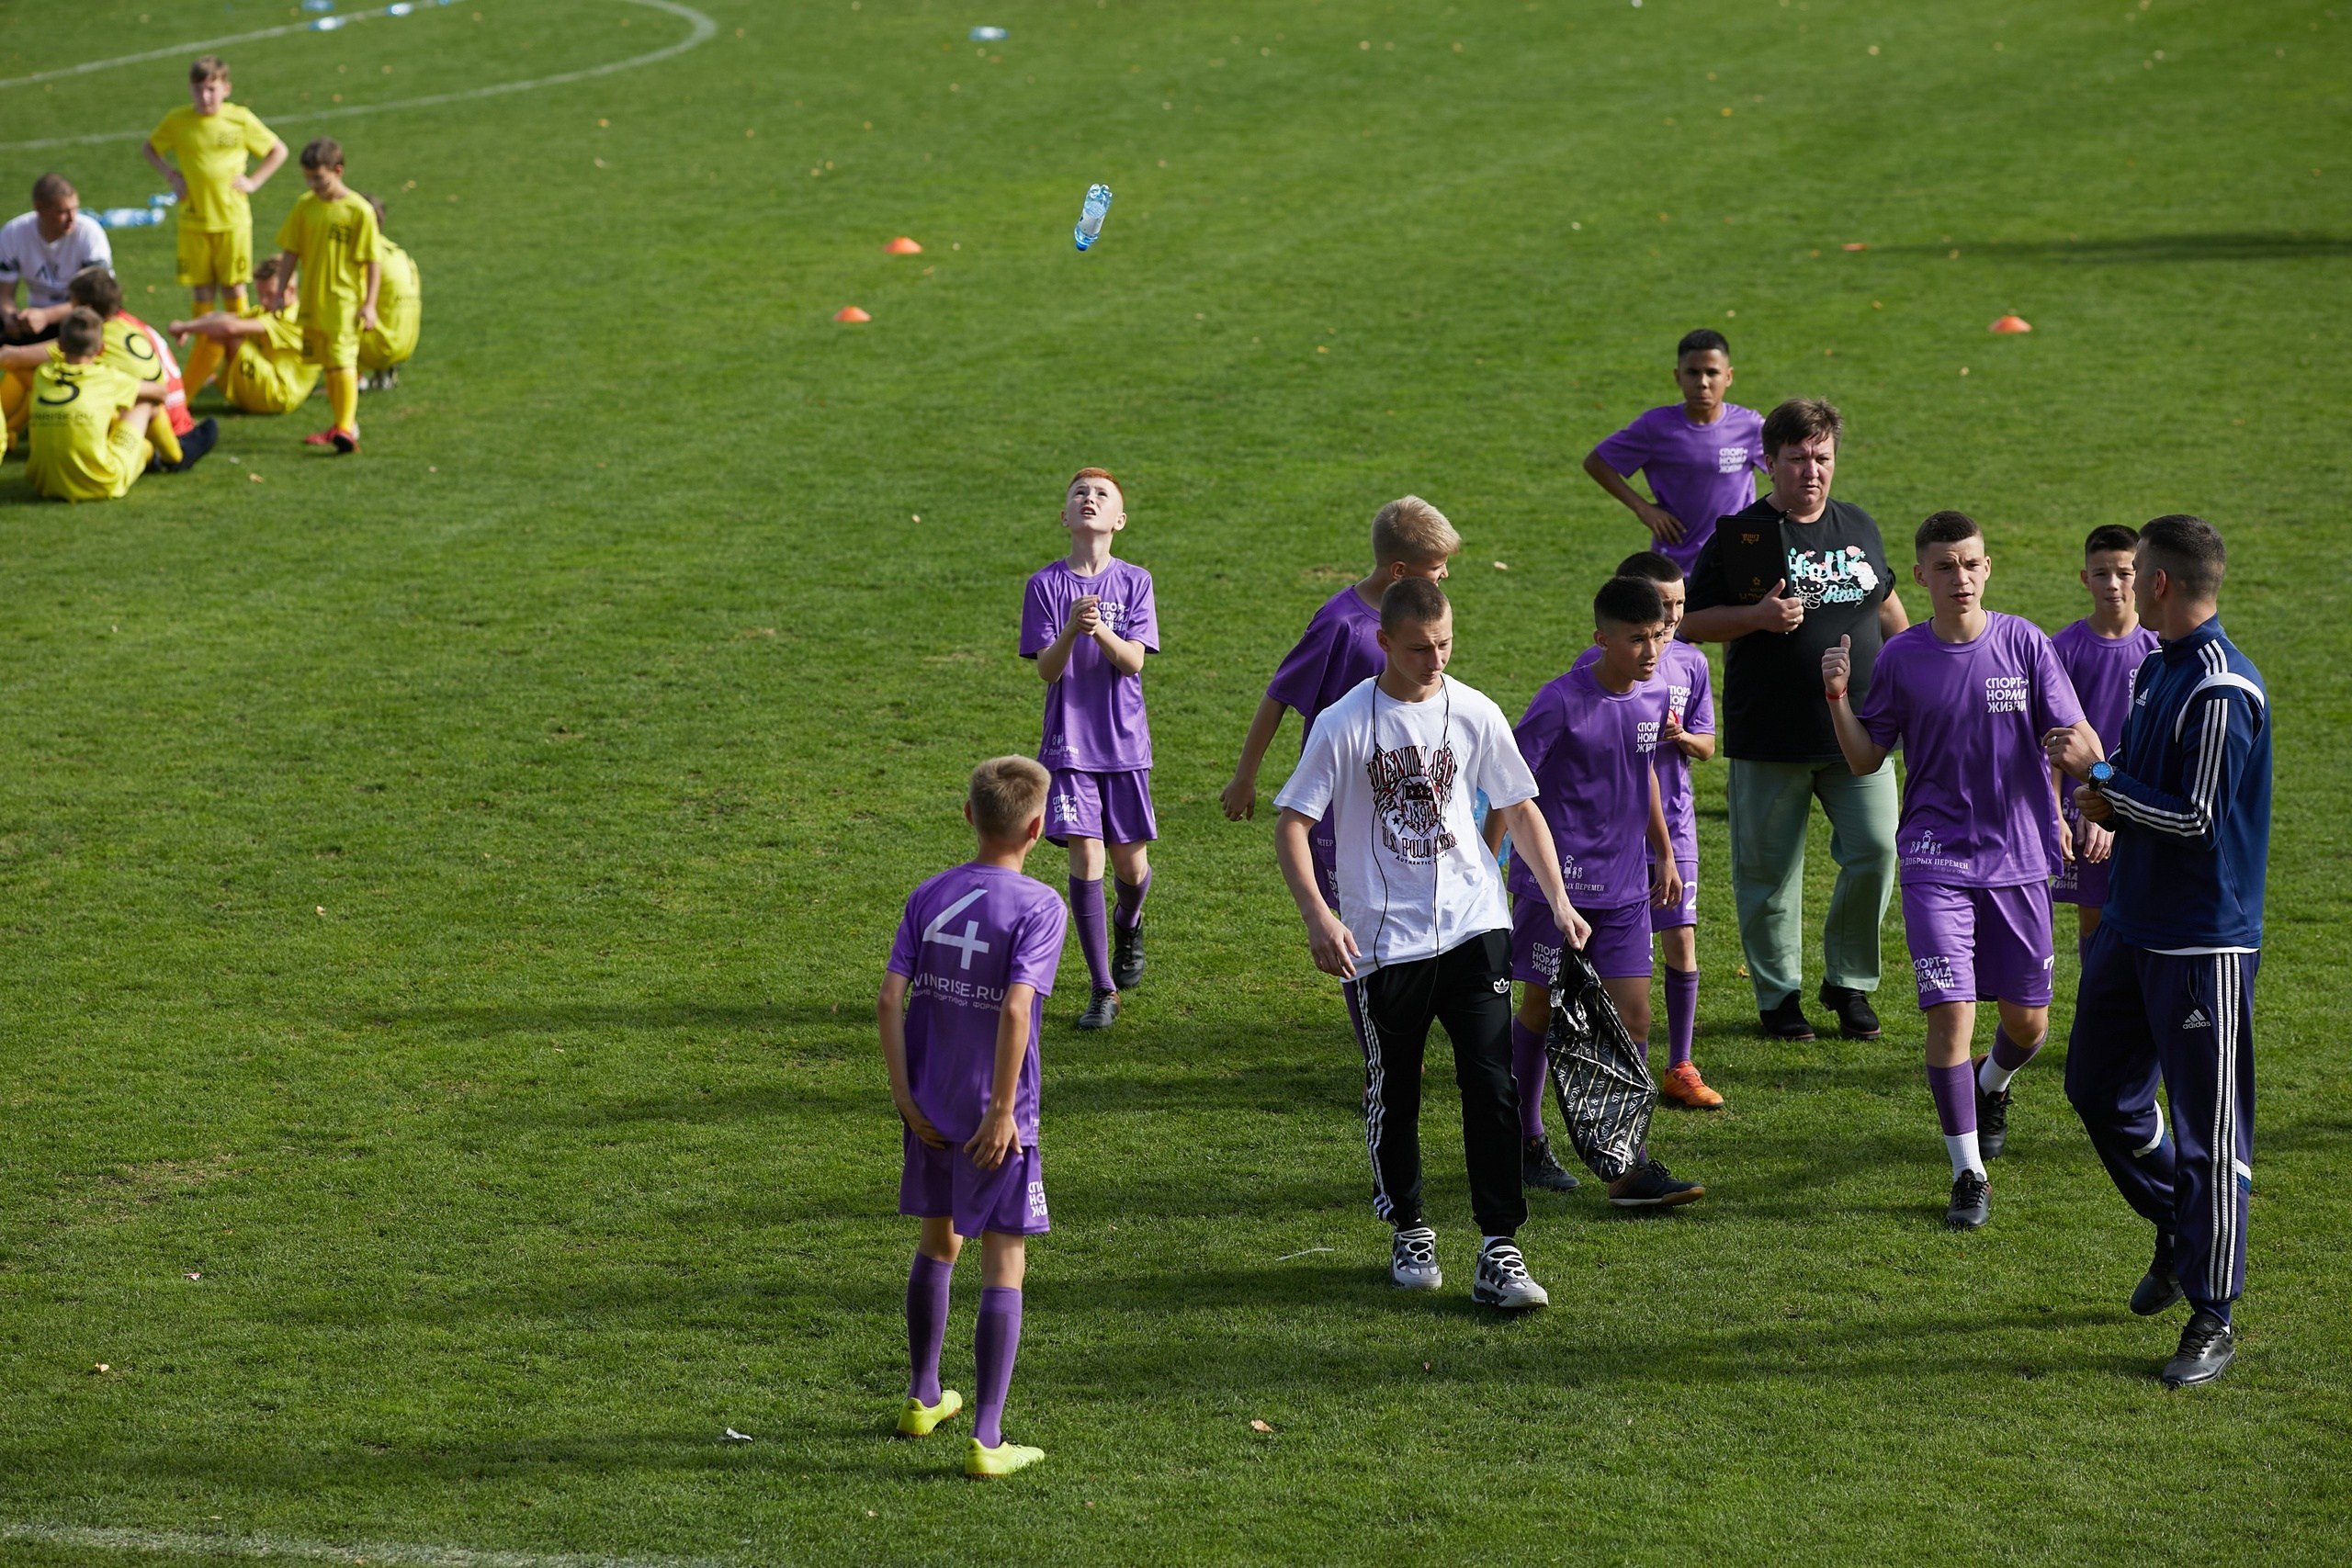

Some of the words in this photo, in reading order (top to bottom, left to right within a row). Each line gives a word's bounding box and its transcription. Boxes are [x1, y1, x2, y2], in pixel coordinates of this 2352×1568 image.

[38, 371, 83, 406] 5
[1985, 677, 2022, 689] СПОРТ
[1986, 689, 2027, 701] НОРМА
[1987, 700, 2027, 713] ЖИЗНИ
[1402, 838, 1432, 858] POLO
[1683, 881, 1697, 910] 2
[922, 887, 989, 971] 4
[1532, 942, 1560, 957] СПОРТ
[913, 972, 1004, 1002] VINRISE.RU
[2182, 1021, 2211, 1030] adidas
[1595, 1067, 1610, 1095] SAMSO
[1611, 1082, 1624, 1104] STON
